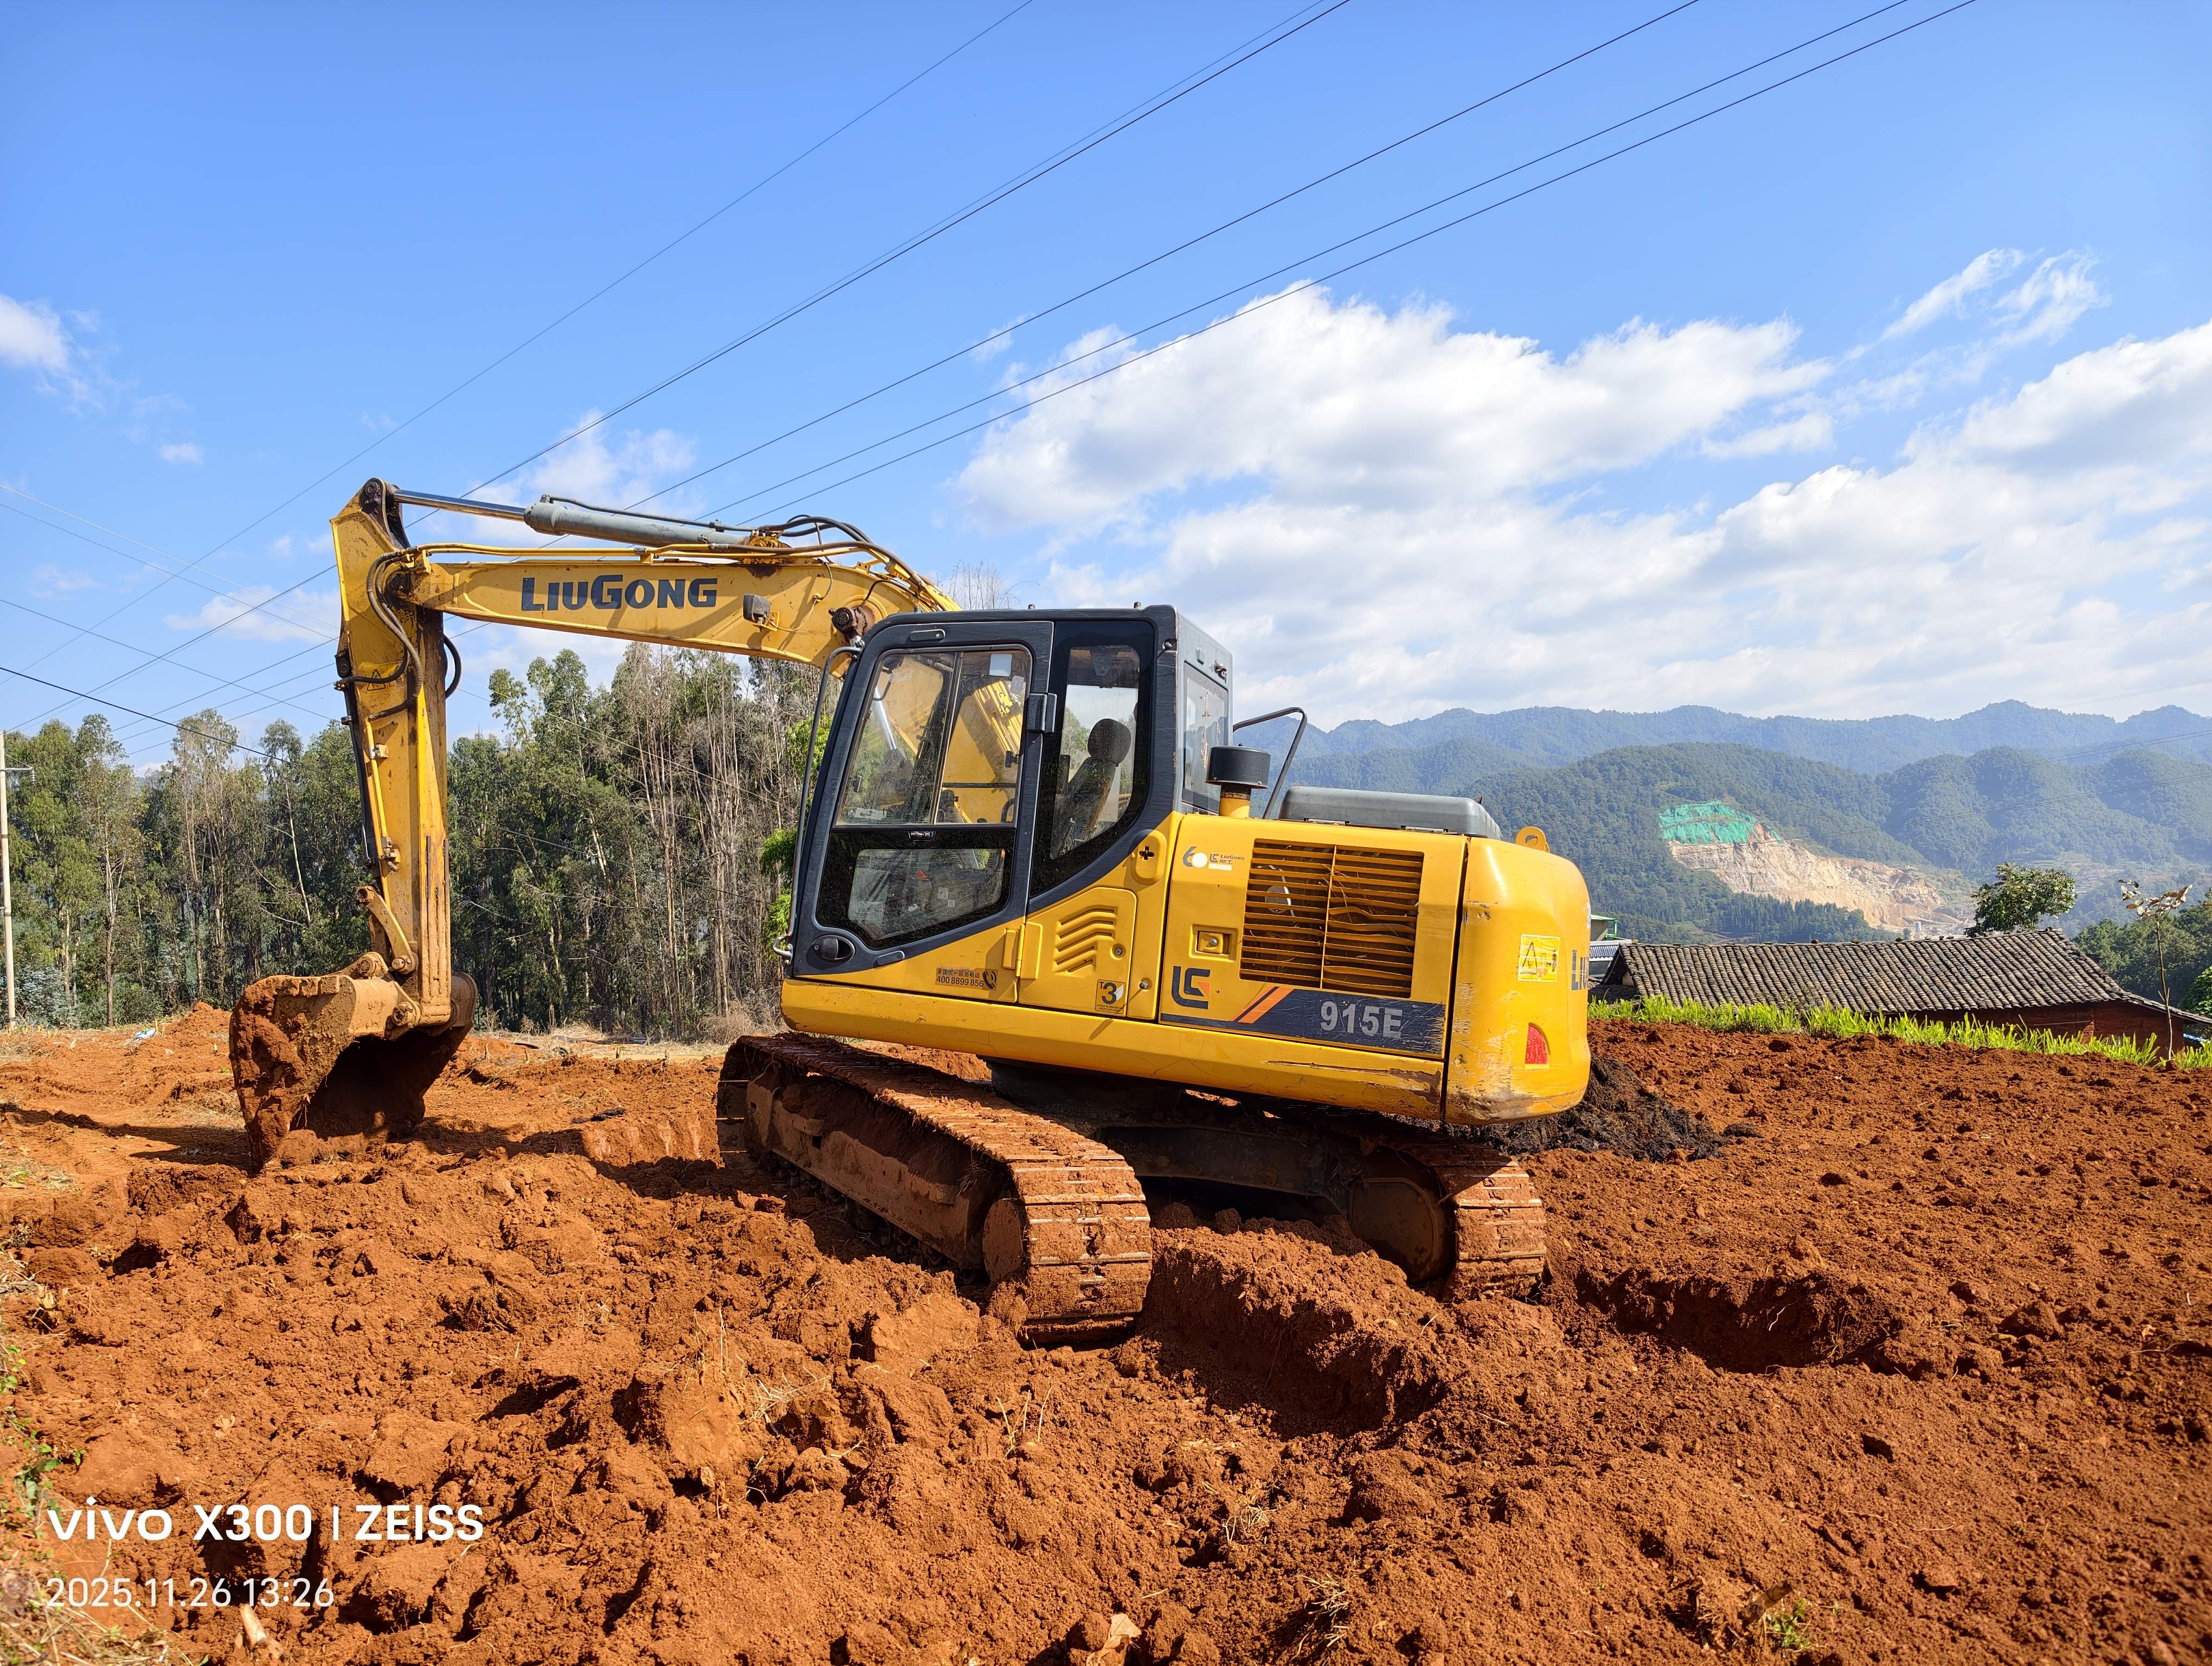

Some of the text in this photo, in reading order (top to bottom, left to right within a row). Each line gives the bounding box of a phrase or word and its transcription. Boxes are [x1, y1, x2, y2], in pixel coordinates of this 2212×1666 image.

[936, 976, 949, 984] 400
[951, 977, 969, 986] 8899
[1320, 1001, 1403, 1039] 915E
